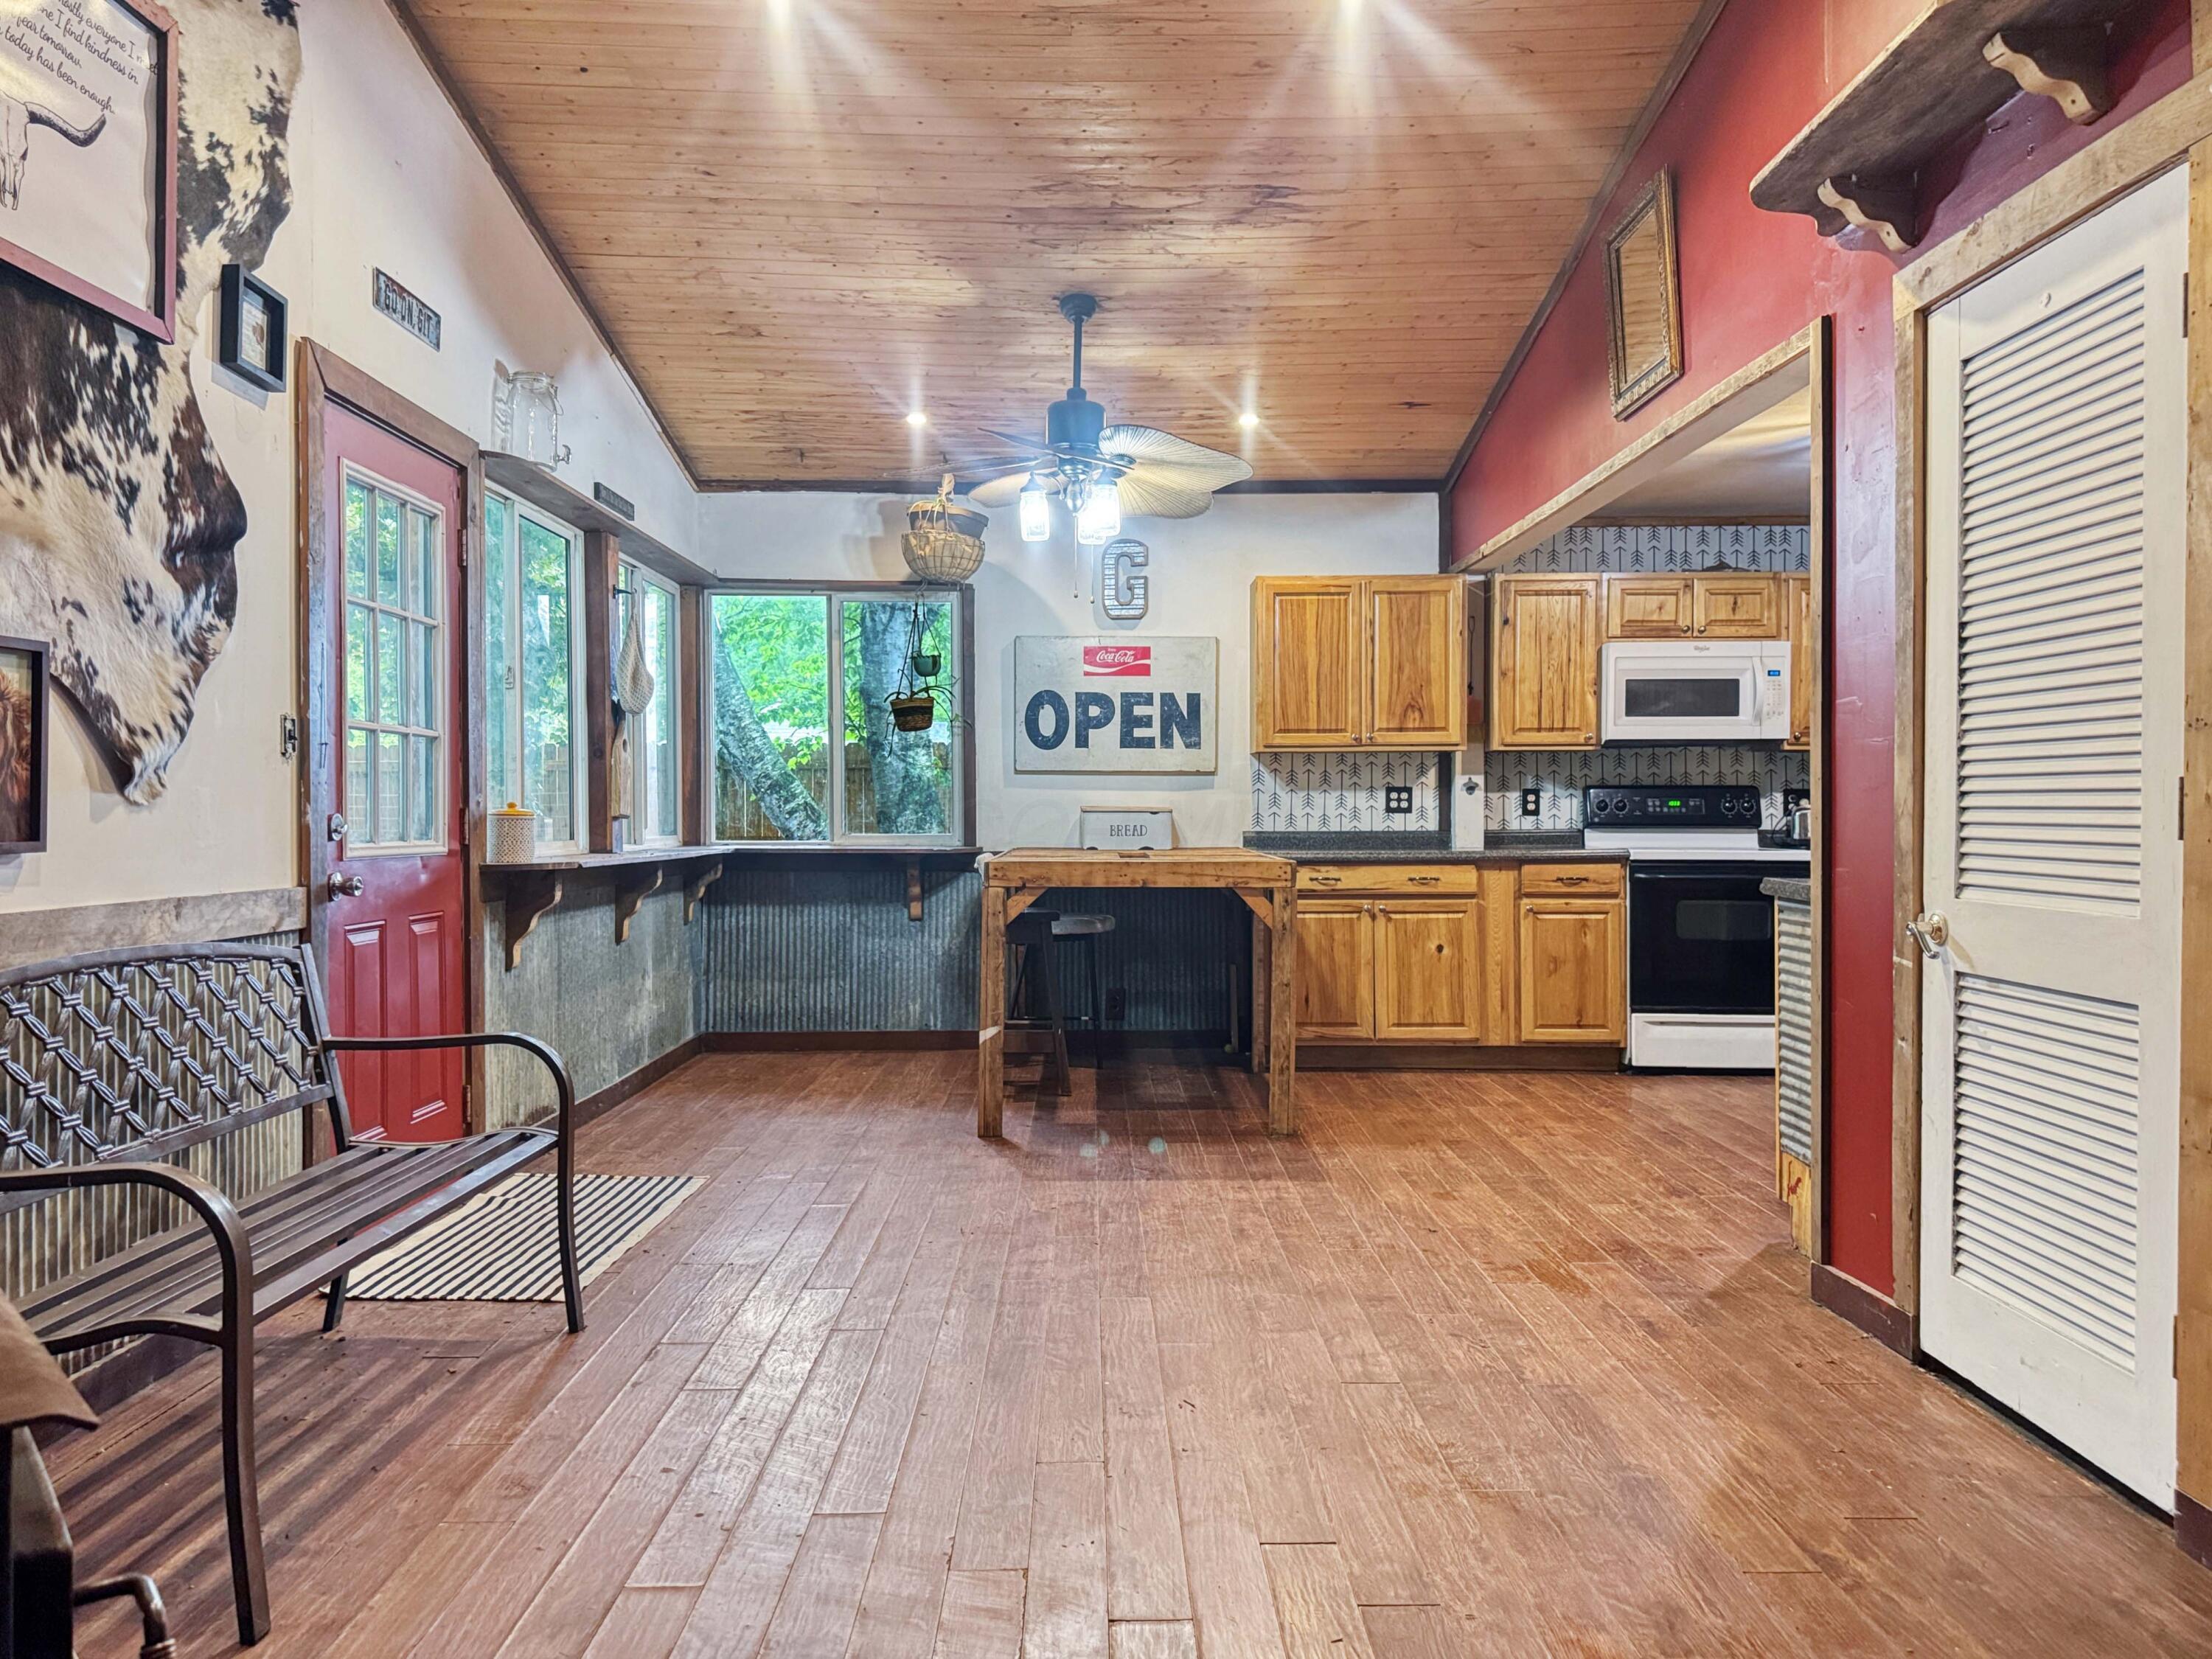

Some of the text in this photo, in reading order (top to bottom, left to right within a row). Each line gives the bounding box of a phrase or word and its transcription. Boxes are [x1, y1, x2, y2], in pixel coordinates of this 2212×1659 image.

[5, 25, 34, 61] today
[37, 46, 54, 73] has
[57, 62, 78, 89] been
[55, 9, 64, 29] I
[63, 18, 85, 45] find
[85, 35, 126, 76] kindness
[86, 18, 127, 52] everyone
[128, 41, 136, 59] I
[384, 282, 398, 316] GO
[417, 307, 433, 340] GIT
[1102, 538, 1148, 619] G
[1096, 650, 1136, 663] Coca-Cola
[1025, 689, 1202, 751] OPEN
[1110, 824, 1148, 837] BREAD
